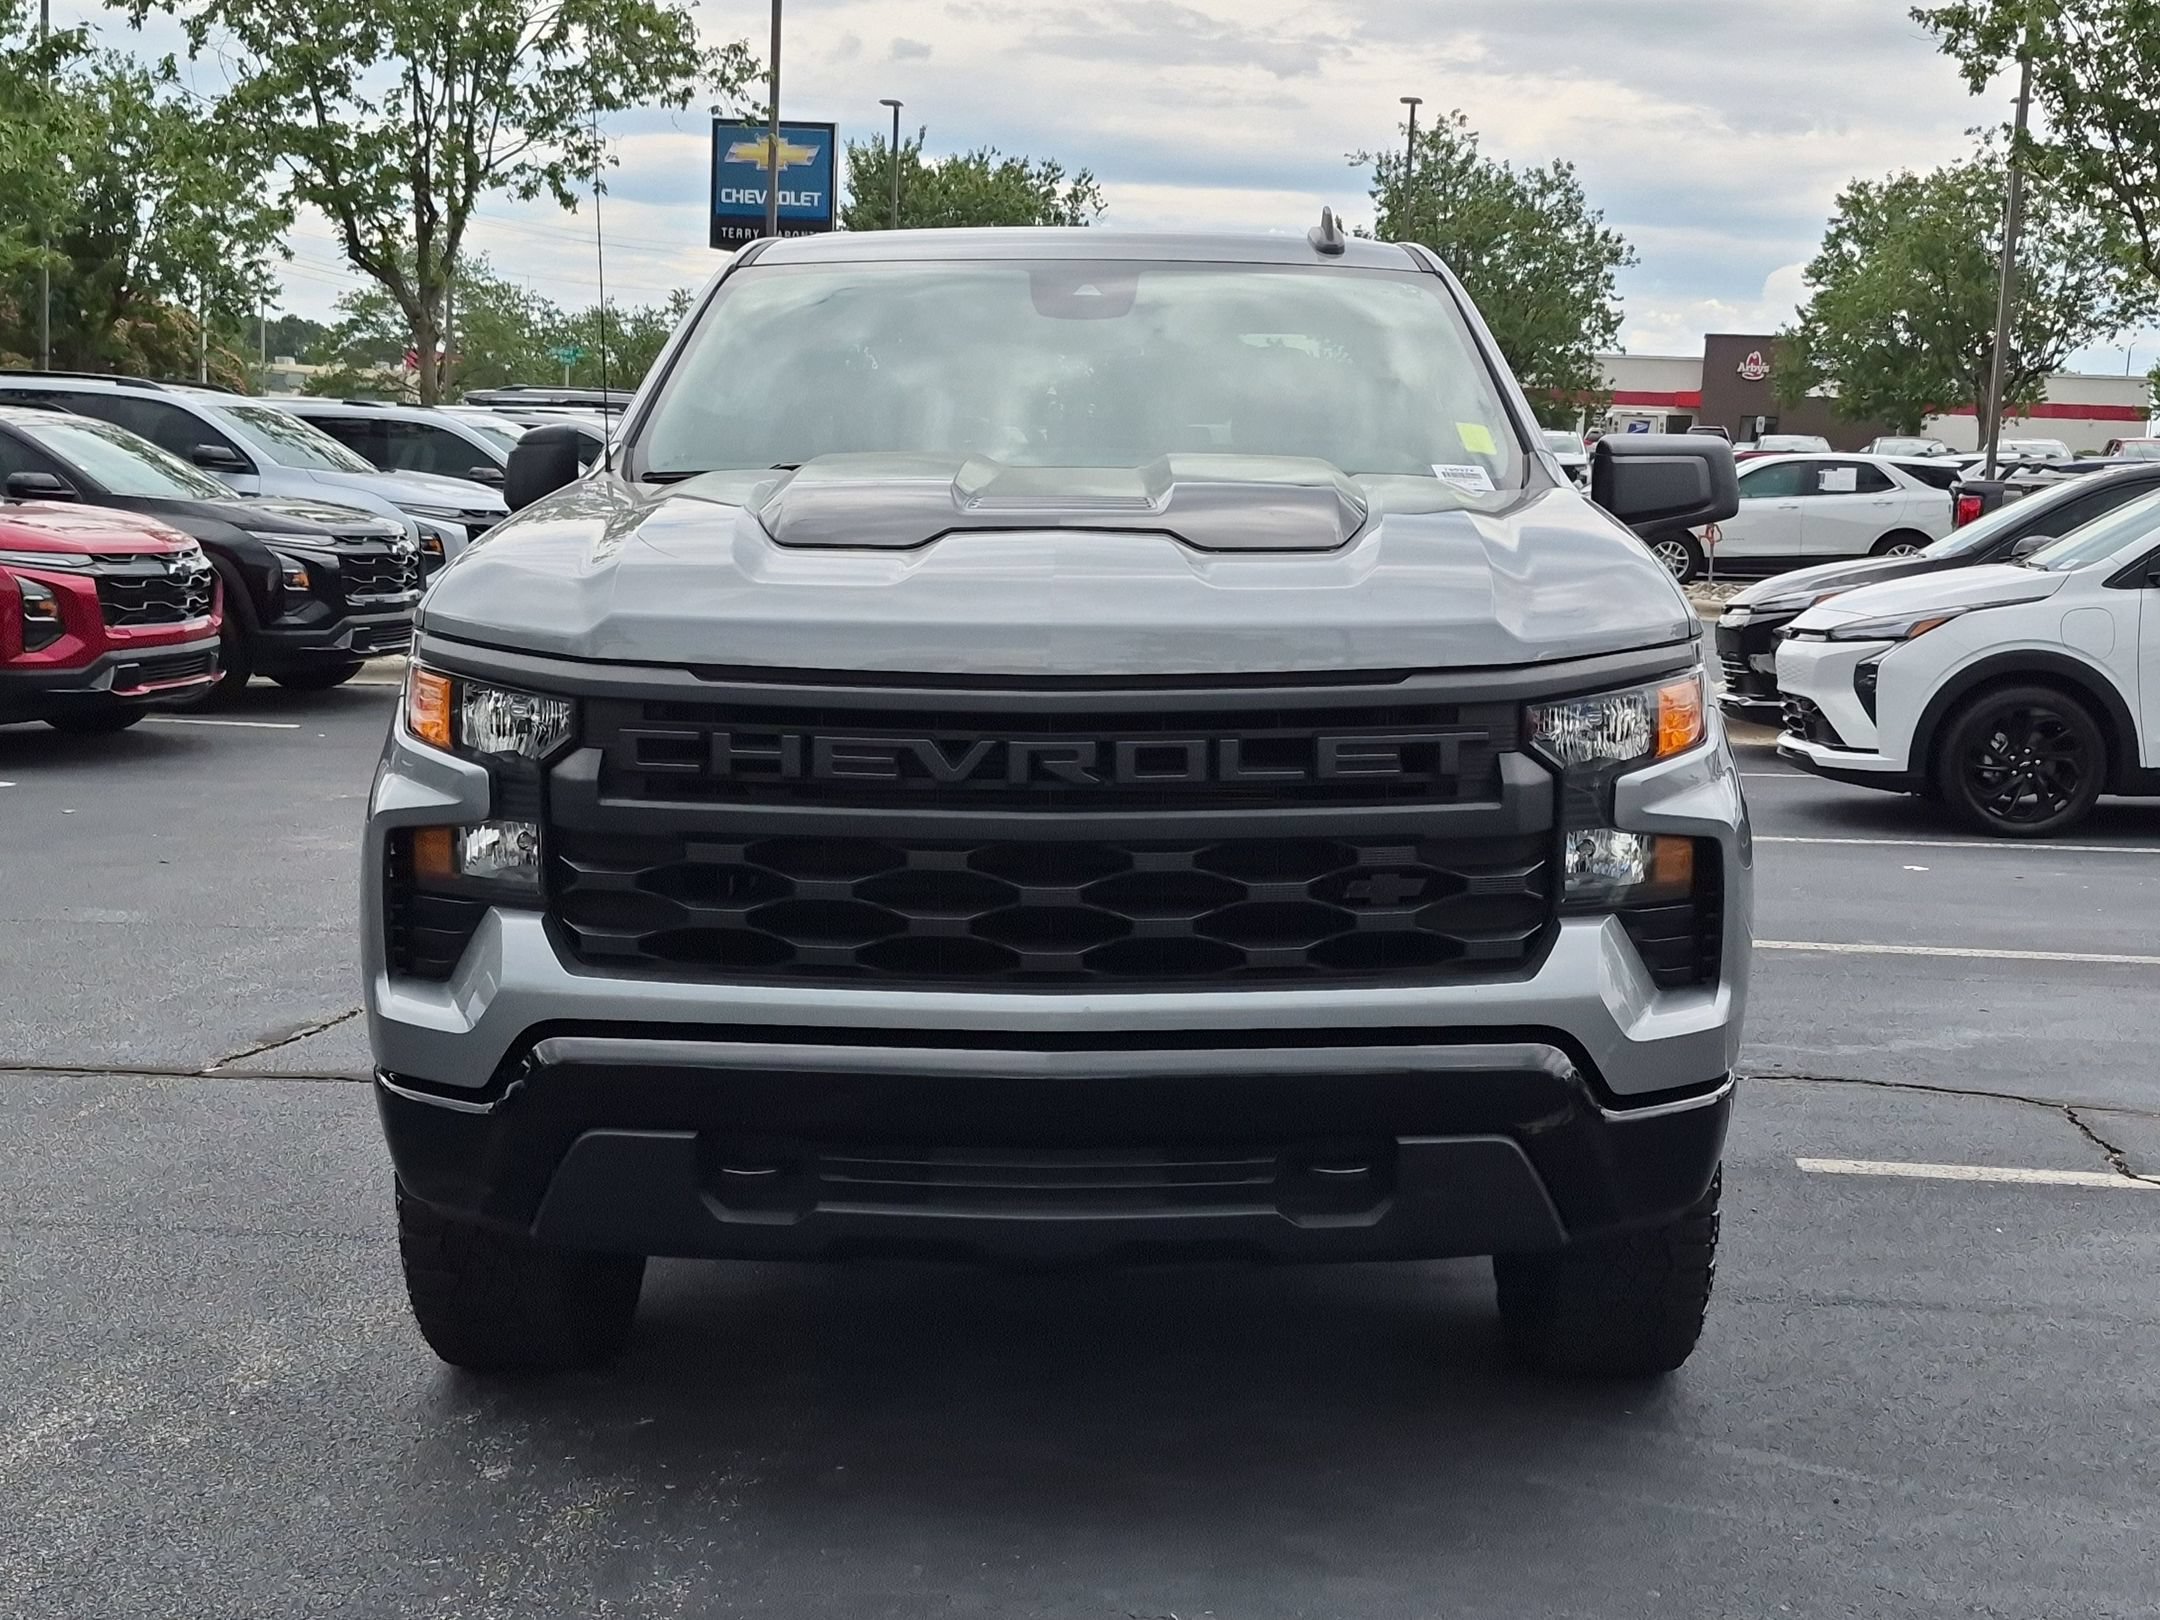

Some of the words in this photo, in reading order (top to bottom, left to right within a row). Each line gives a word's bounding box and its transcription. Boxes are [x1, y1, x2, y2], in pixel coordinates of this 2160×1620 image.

[721, 188, 822, 207] CHEVOLET
[721, 227, 760, 239] TERRY
[1737, 362, 1770, 375] Arby's
[616, 726, 1491, 786] CHEVROLET
